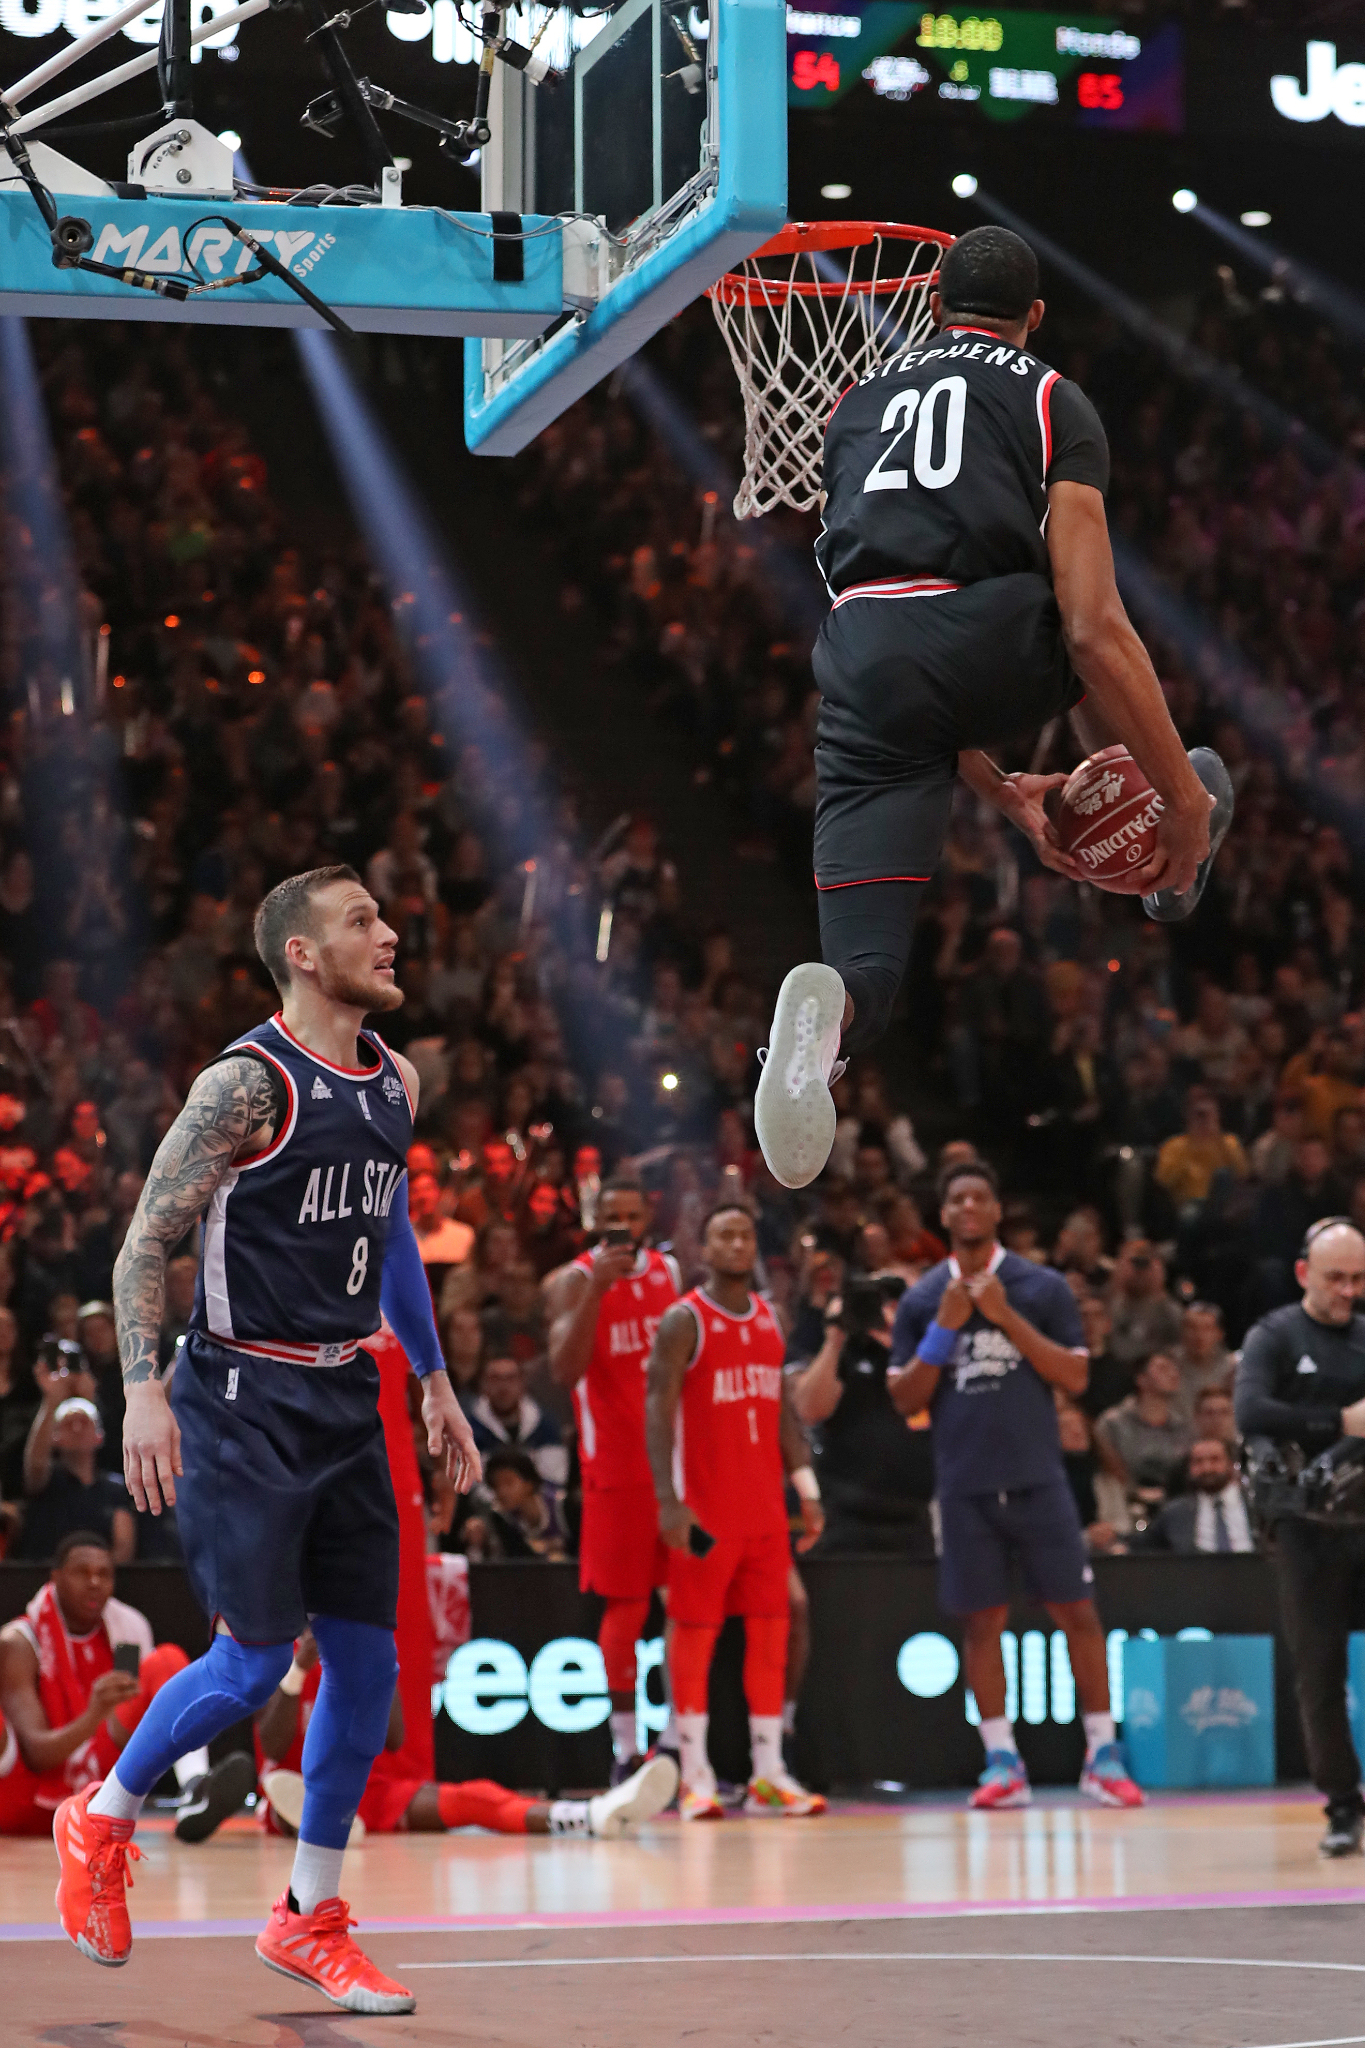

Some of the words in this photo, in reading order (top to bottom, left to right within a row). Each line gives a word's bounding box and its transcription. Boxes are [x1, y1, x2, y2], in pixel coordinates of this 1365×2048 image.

[92, 223, 315, 275] MARTY
[293, 233, 337, 277] Sports
[858, 343, 1035, 387] STEPHENS
[864, 376, 967, 493] 20
[298, 1163, 352, 1224] ALL
[346, 1237, 368, 1295] 8
